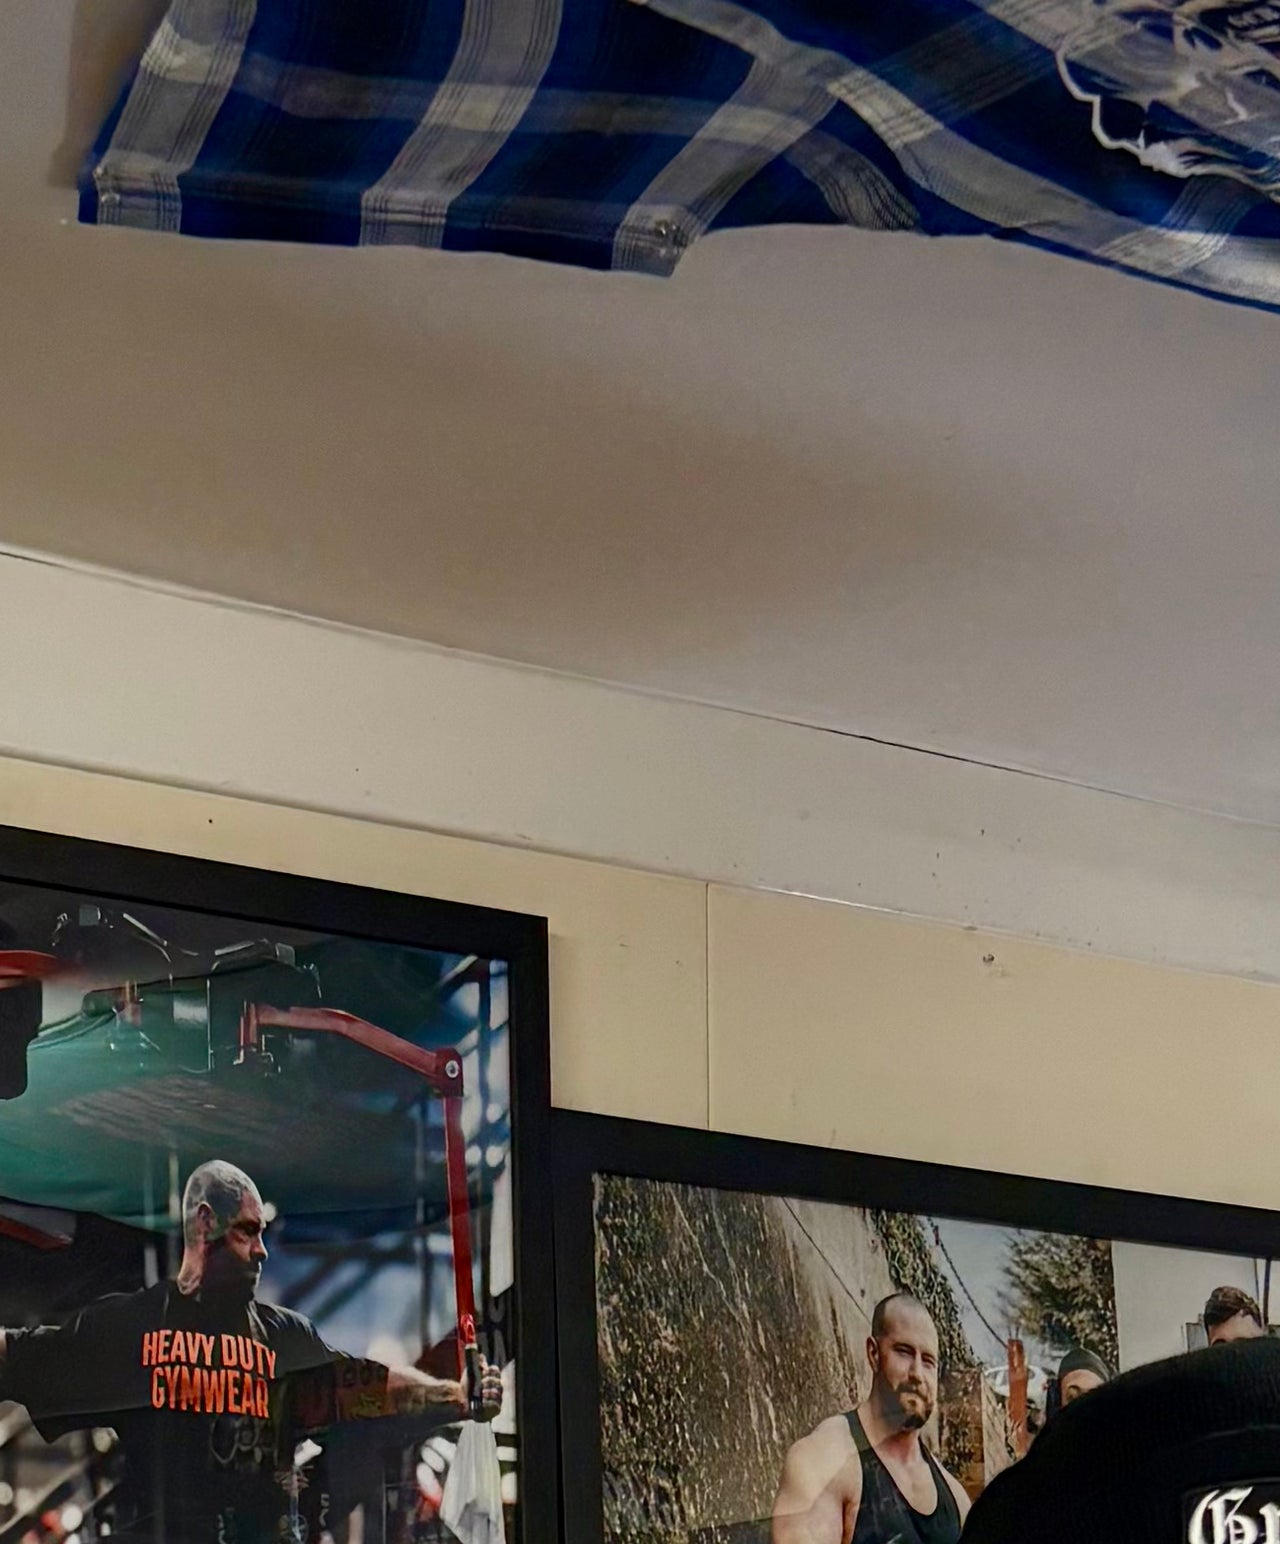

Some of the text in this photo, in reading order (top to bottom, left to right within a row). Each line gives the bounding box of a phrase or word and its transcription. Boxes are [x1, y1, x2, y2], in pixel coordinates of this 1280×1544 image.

[142, 1329, 277, 1380] HEAVY DUTY
[151, 1365, 270, 1419] GYMWEAR
